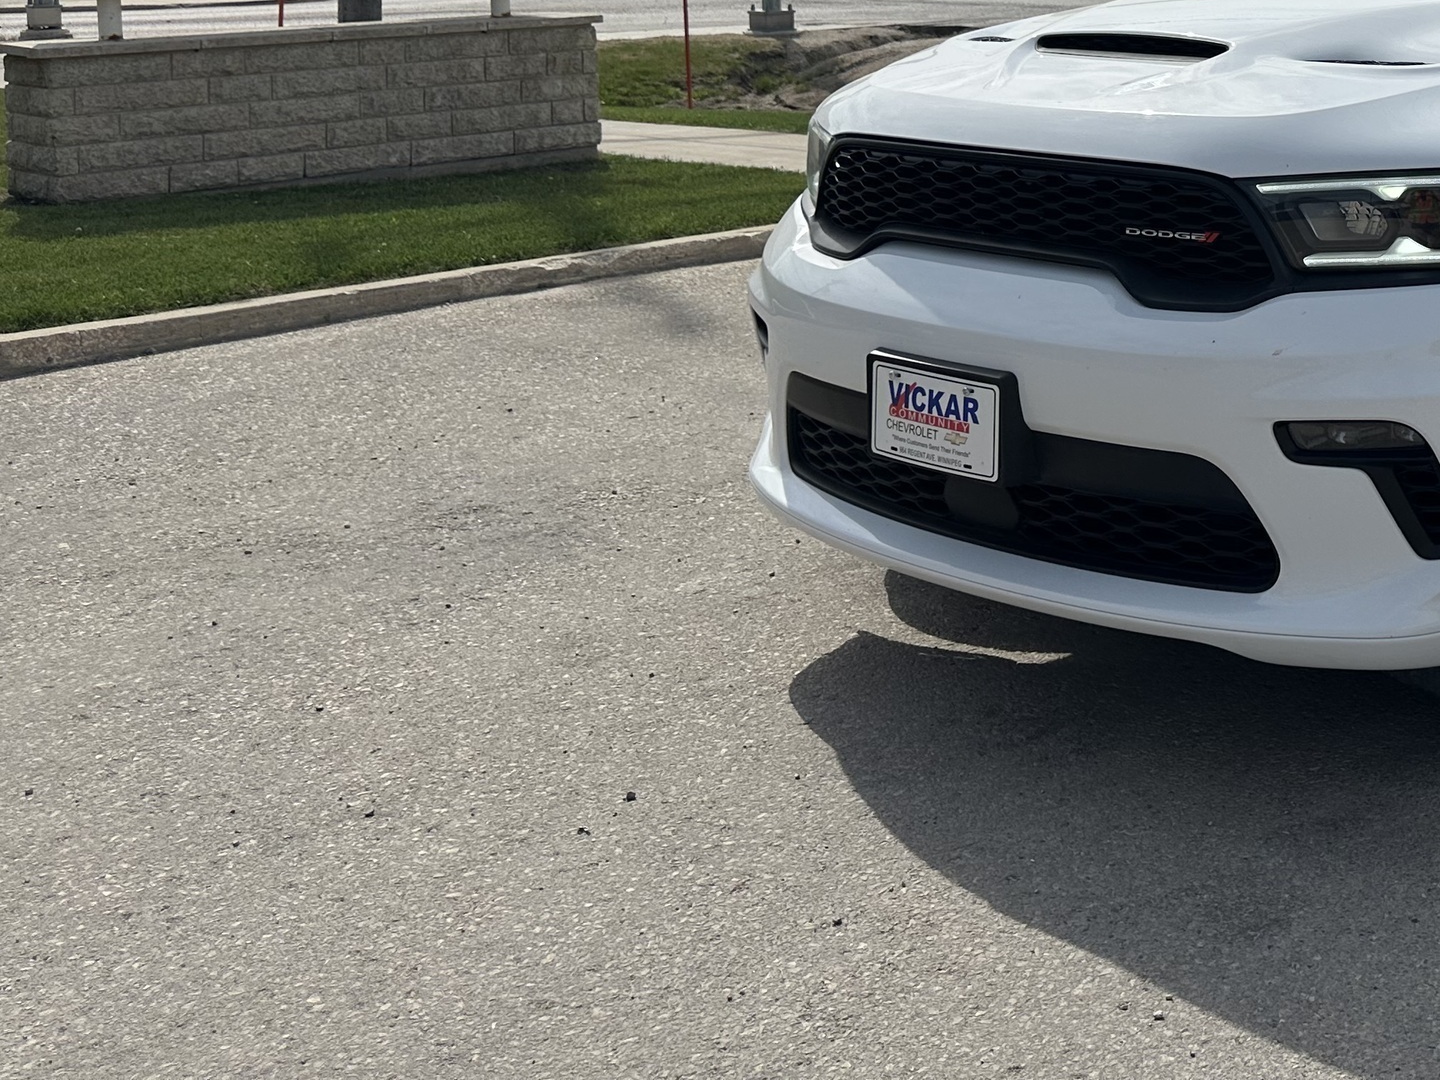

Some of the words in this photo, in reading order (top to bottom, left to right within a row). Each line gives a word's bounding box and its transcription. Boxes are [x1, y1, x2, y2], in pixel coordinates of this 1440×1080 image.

[1125, 227, 1207, 241] DODGE
[888, 380, 980, 425] VICKAR
[886, 418, 939, 440] CHEVROLET
[890, 407, 970, 432] COMMUNITY
